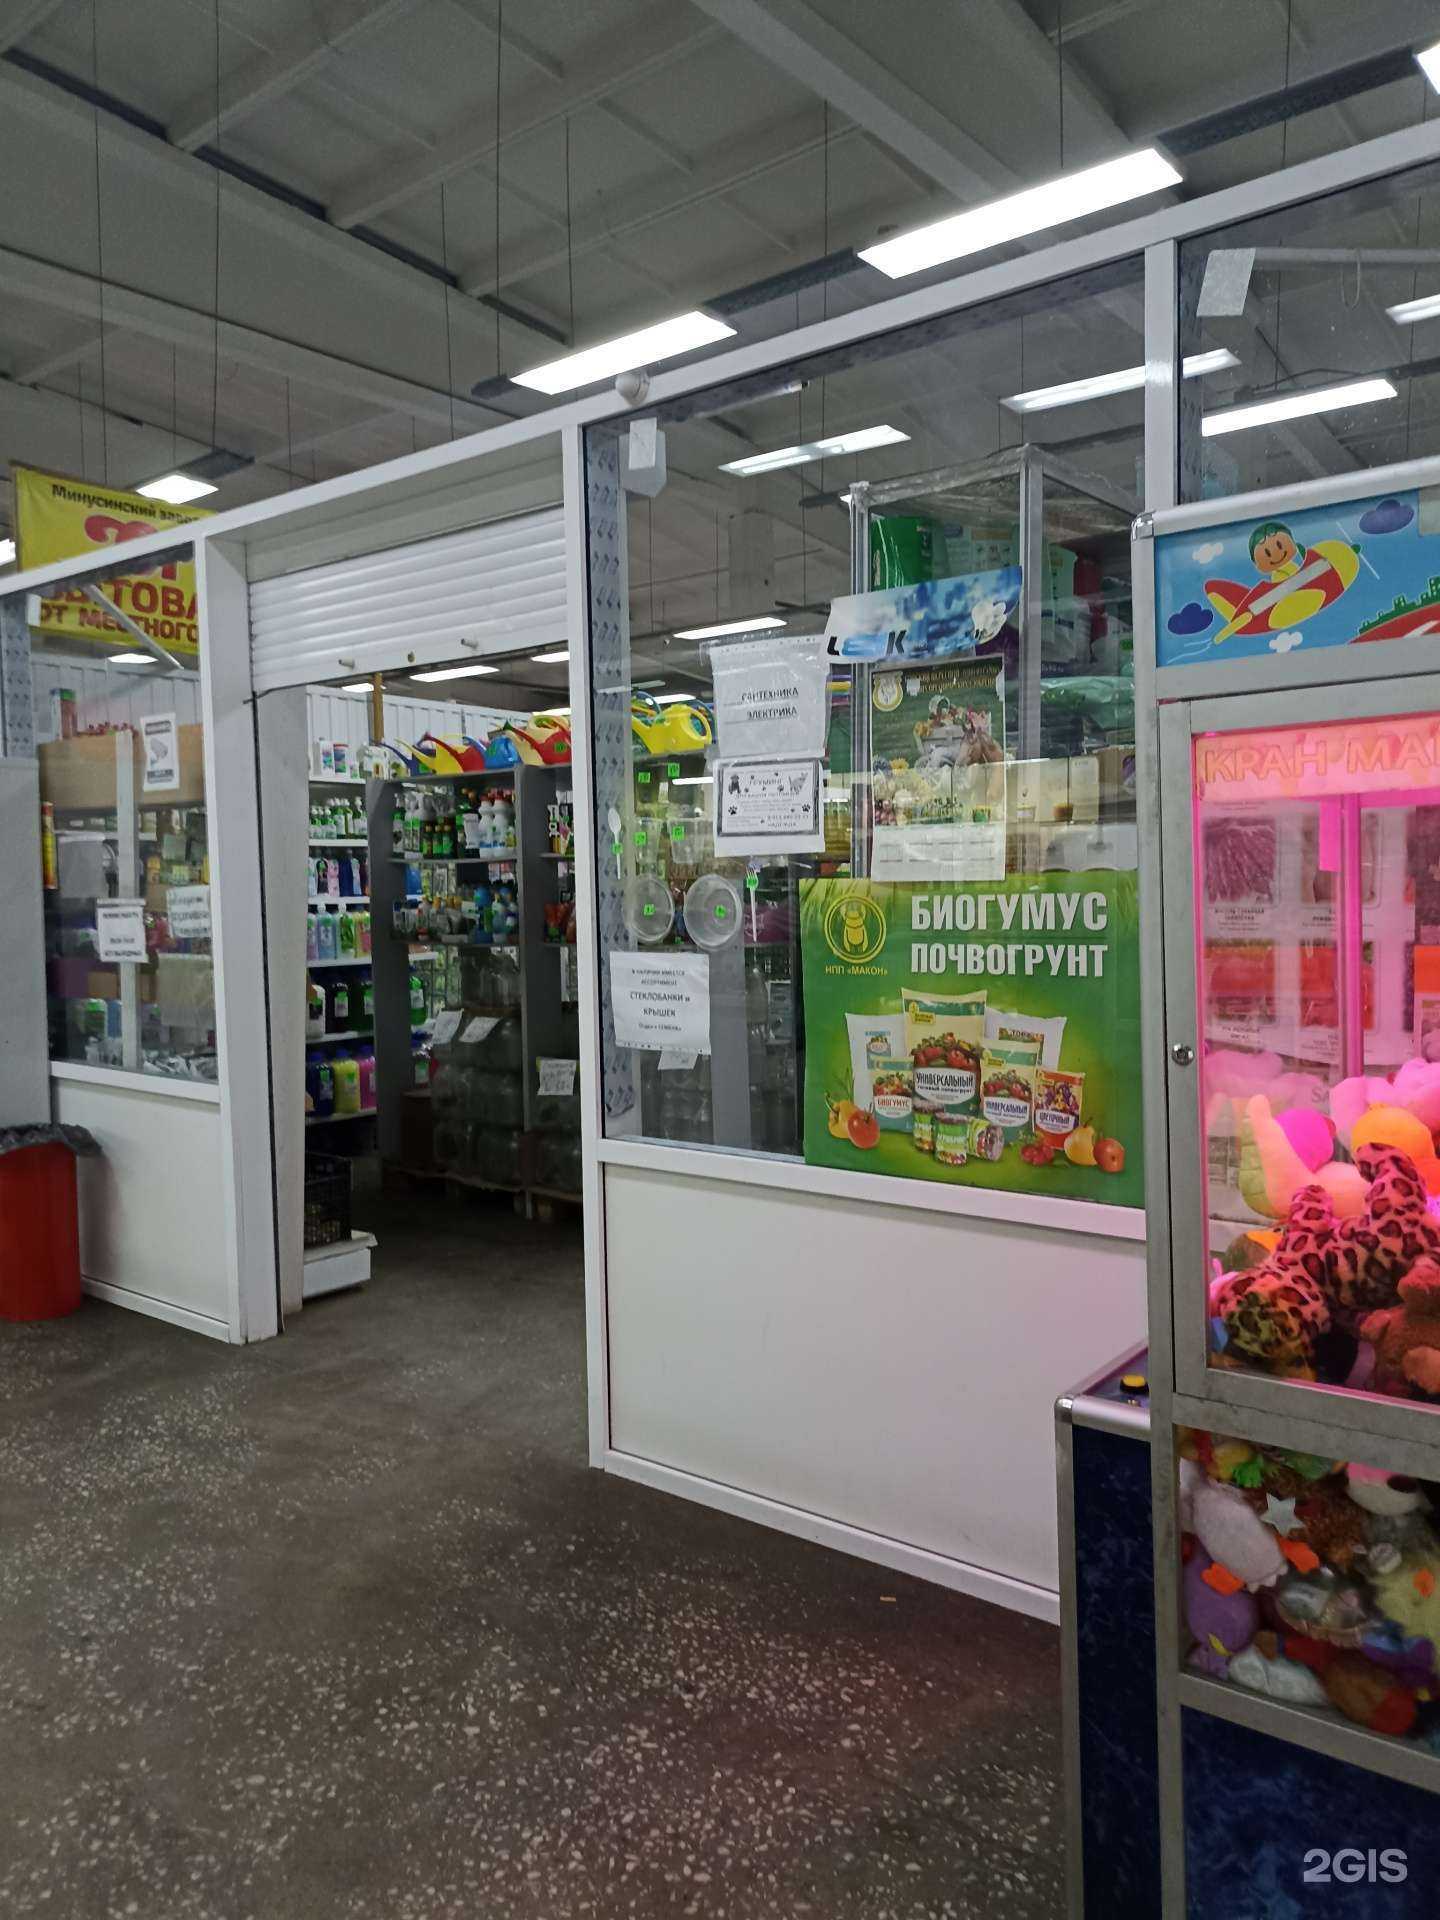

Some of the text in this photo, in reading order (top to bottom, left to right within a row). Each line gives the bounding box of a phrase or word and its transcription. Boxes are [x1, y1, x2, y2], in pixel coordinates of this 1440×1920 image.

[51, 484, 156, 518] Минусинский
[741, 687, 799, 701] САНТЕХНИКА
[747, 706, 797, 720] ЭЛЕКТРИКА
[1205, 732, 1440, 783] КРАН МА
[911, 891, 1108, 931] БИОГУМУС
[825, 964, 845, 975] НПП
[911, 942, 1109, 978] ПОЧВОГРУНТ
[916, 1072, 974, 1088] УНИВЕРСАЛЬНЫЙ
